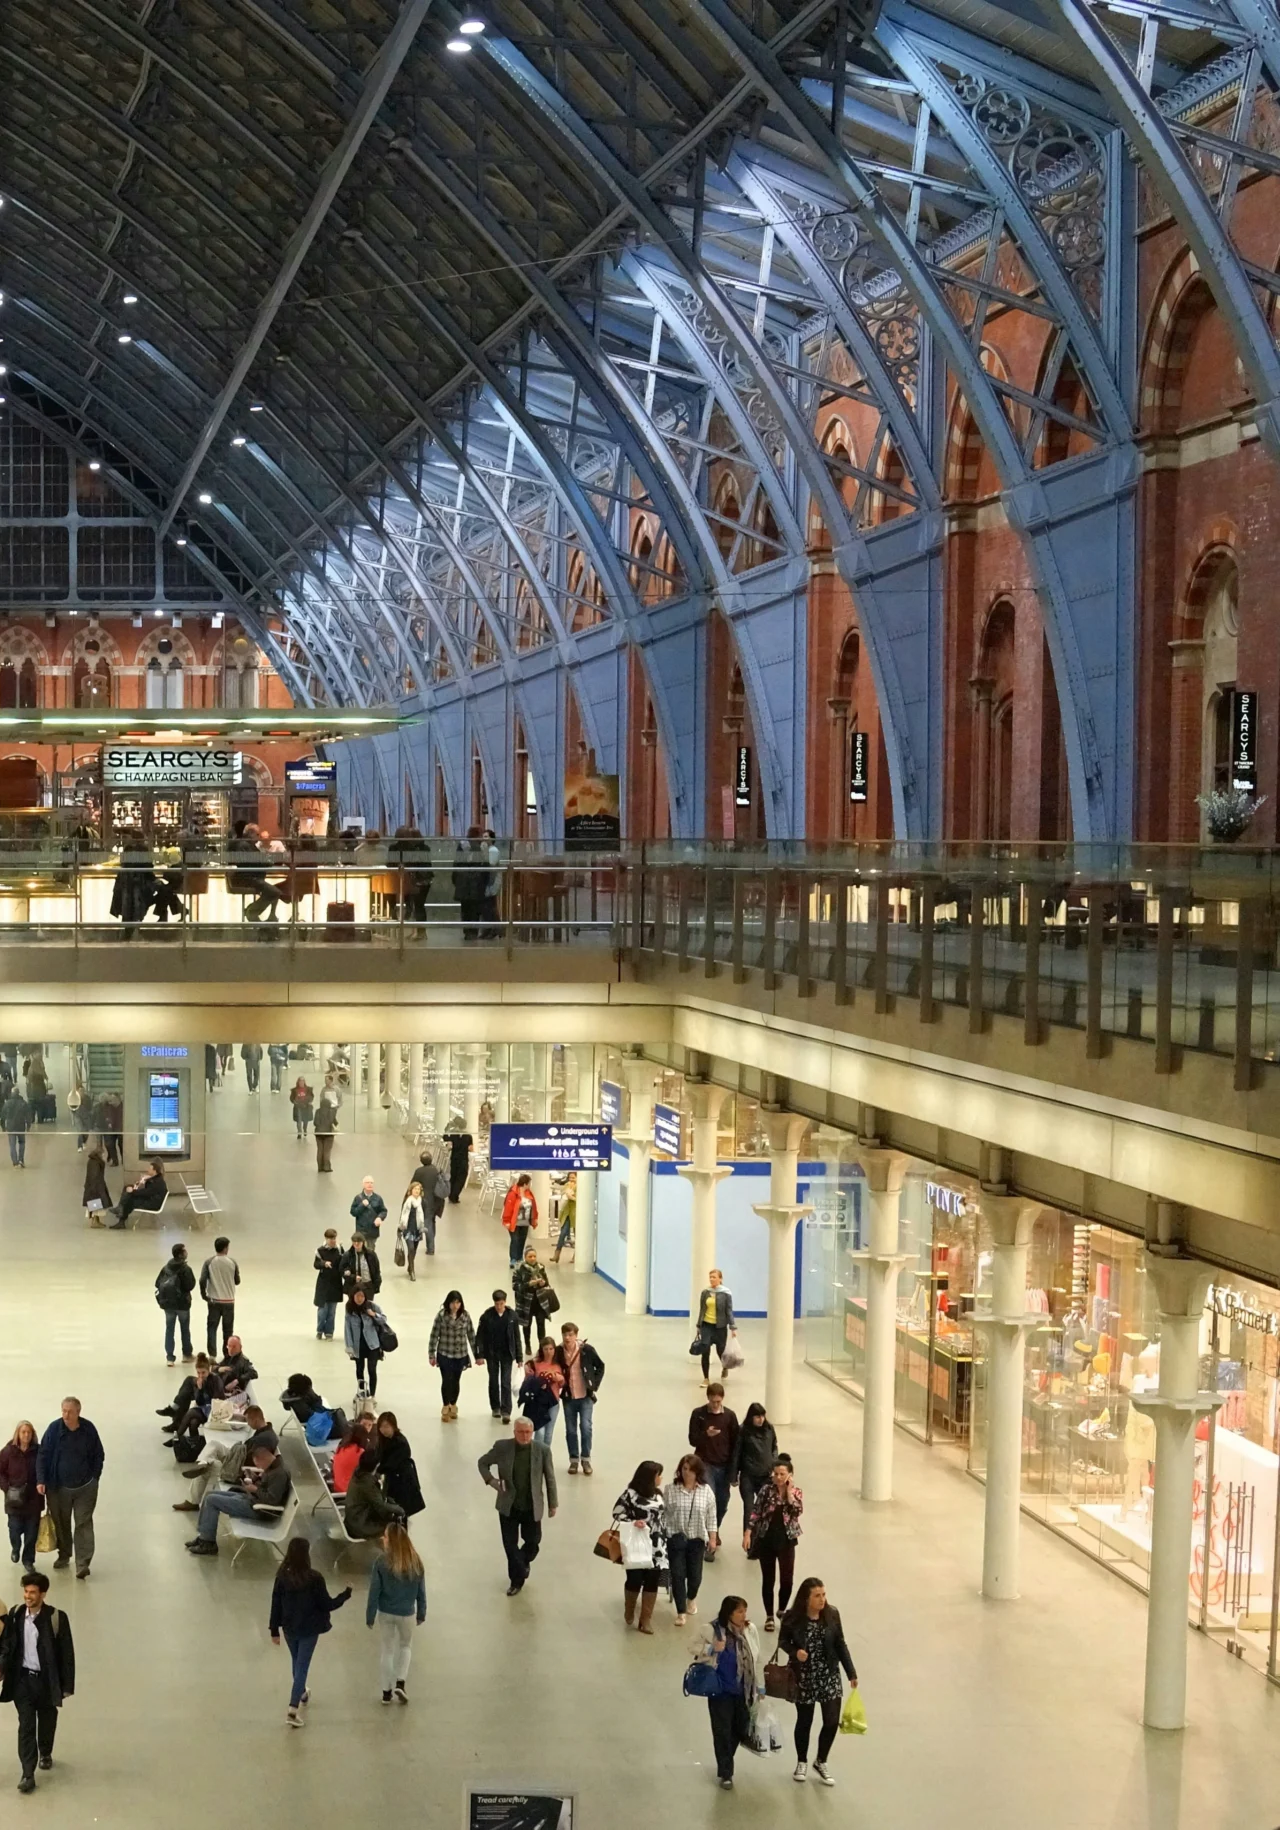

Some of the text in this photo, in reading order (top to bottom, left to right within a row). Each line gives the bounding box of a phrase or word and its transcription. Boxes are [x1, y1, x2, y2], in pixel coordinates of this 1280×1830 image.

[1240, 694, 1250, 761] SEARCYS
[107, 751, 229, 768] SEARCYS
[855, 733, 863, 780] SEARCYS
[113, 772, 224, 782] CHAMPAGNE BAR
[560, 1127, 599, 1136] Underground
[580, 1137, 599, 1146] Billets
[925, 1182, 967, 1218] PINK
[477, 1796, 529, 1805] Tread carefully
